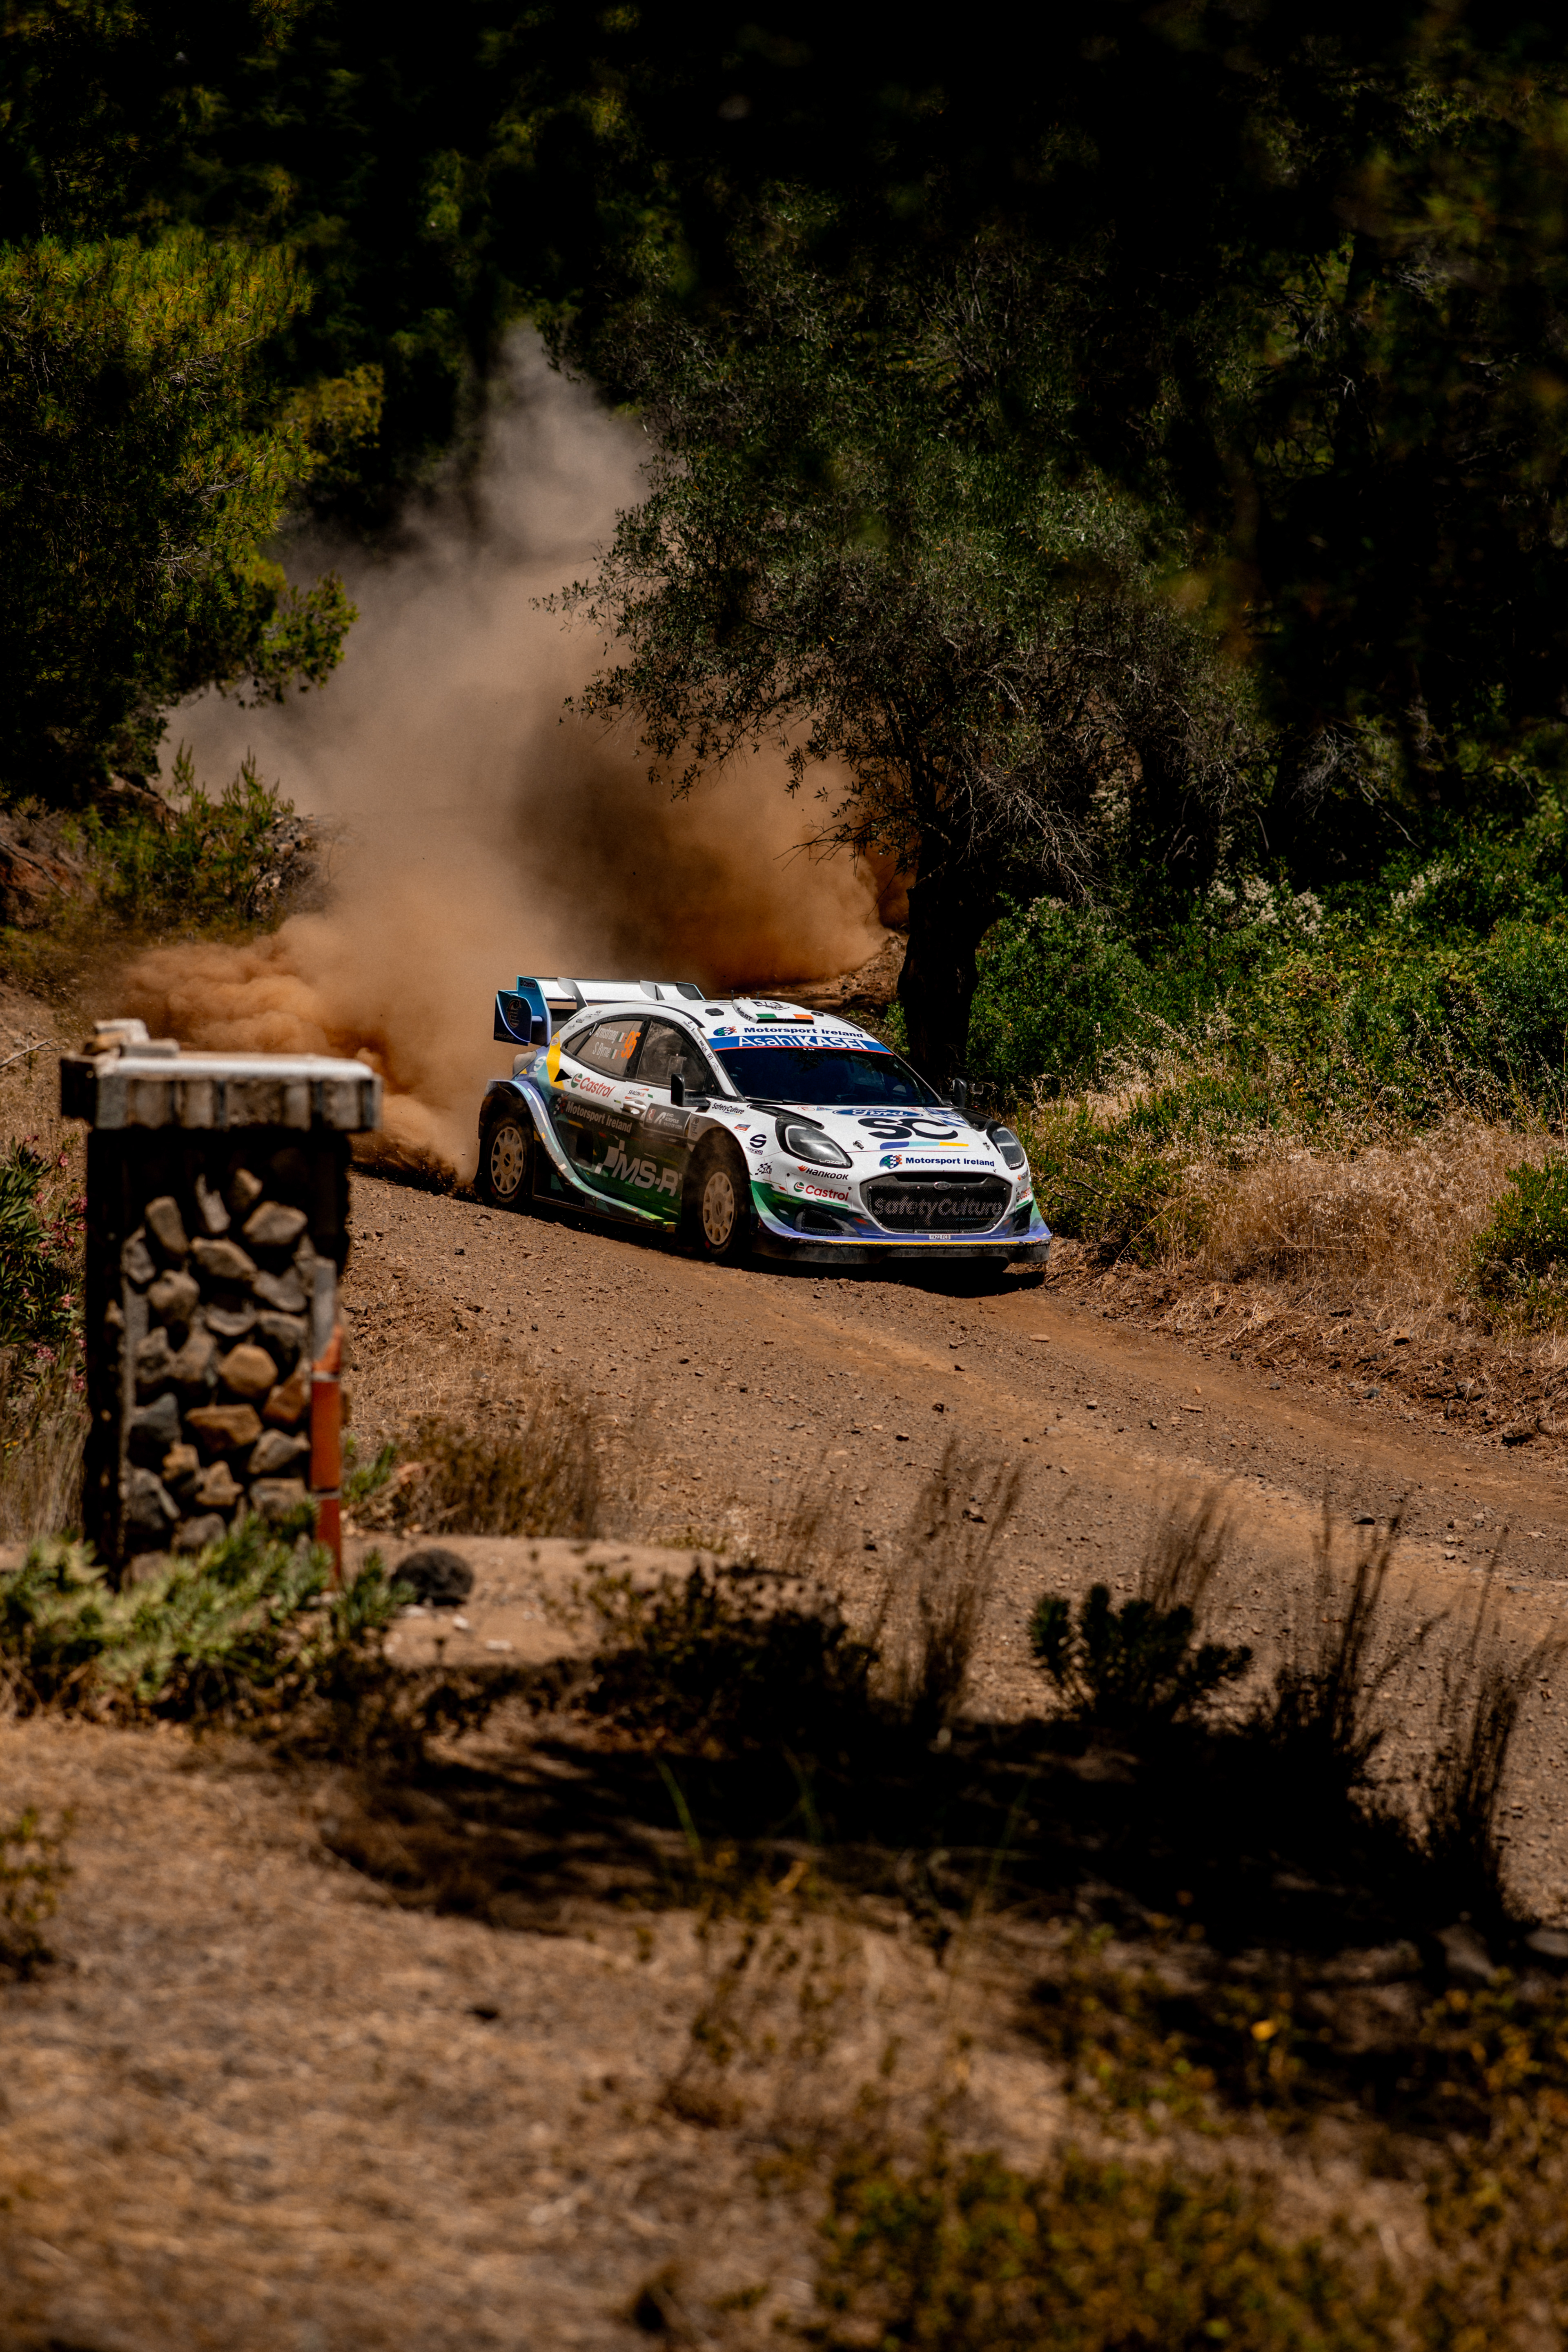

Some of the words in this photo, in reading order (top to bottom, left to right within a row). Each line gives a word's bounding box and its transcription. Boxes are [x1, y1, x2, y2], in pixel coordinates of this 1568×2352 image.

[523, 980, 536, 988] Castrol
[589, 1023, 597, 1036] J
[594, 1024, 619, 1044] Armstrong
[821, 1029, 863, 1038] Ireland
[592, 1041, 599, 1055] S
[596, 1042, 611, 1059] Byrne
[621, 1031, 641, 1059] 95
[579, 1077, 616, 1098] Castrol
[565, 1100, 606, 1124] Motorsport
[606, 1115, 633, 1134] Ireland
[712, 1103, 745, 1114] SafetyCulture
[964, 1158, 995, 1167] Ireland
[611, 1153, 682, 1200] MS-R
[805, 1185, 849, 1201] Castrol
[1020, 1186, 1032, 1200] Castro
[874, 1194, 1002, 1226] SafetyCulture
